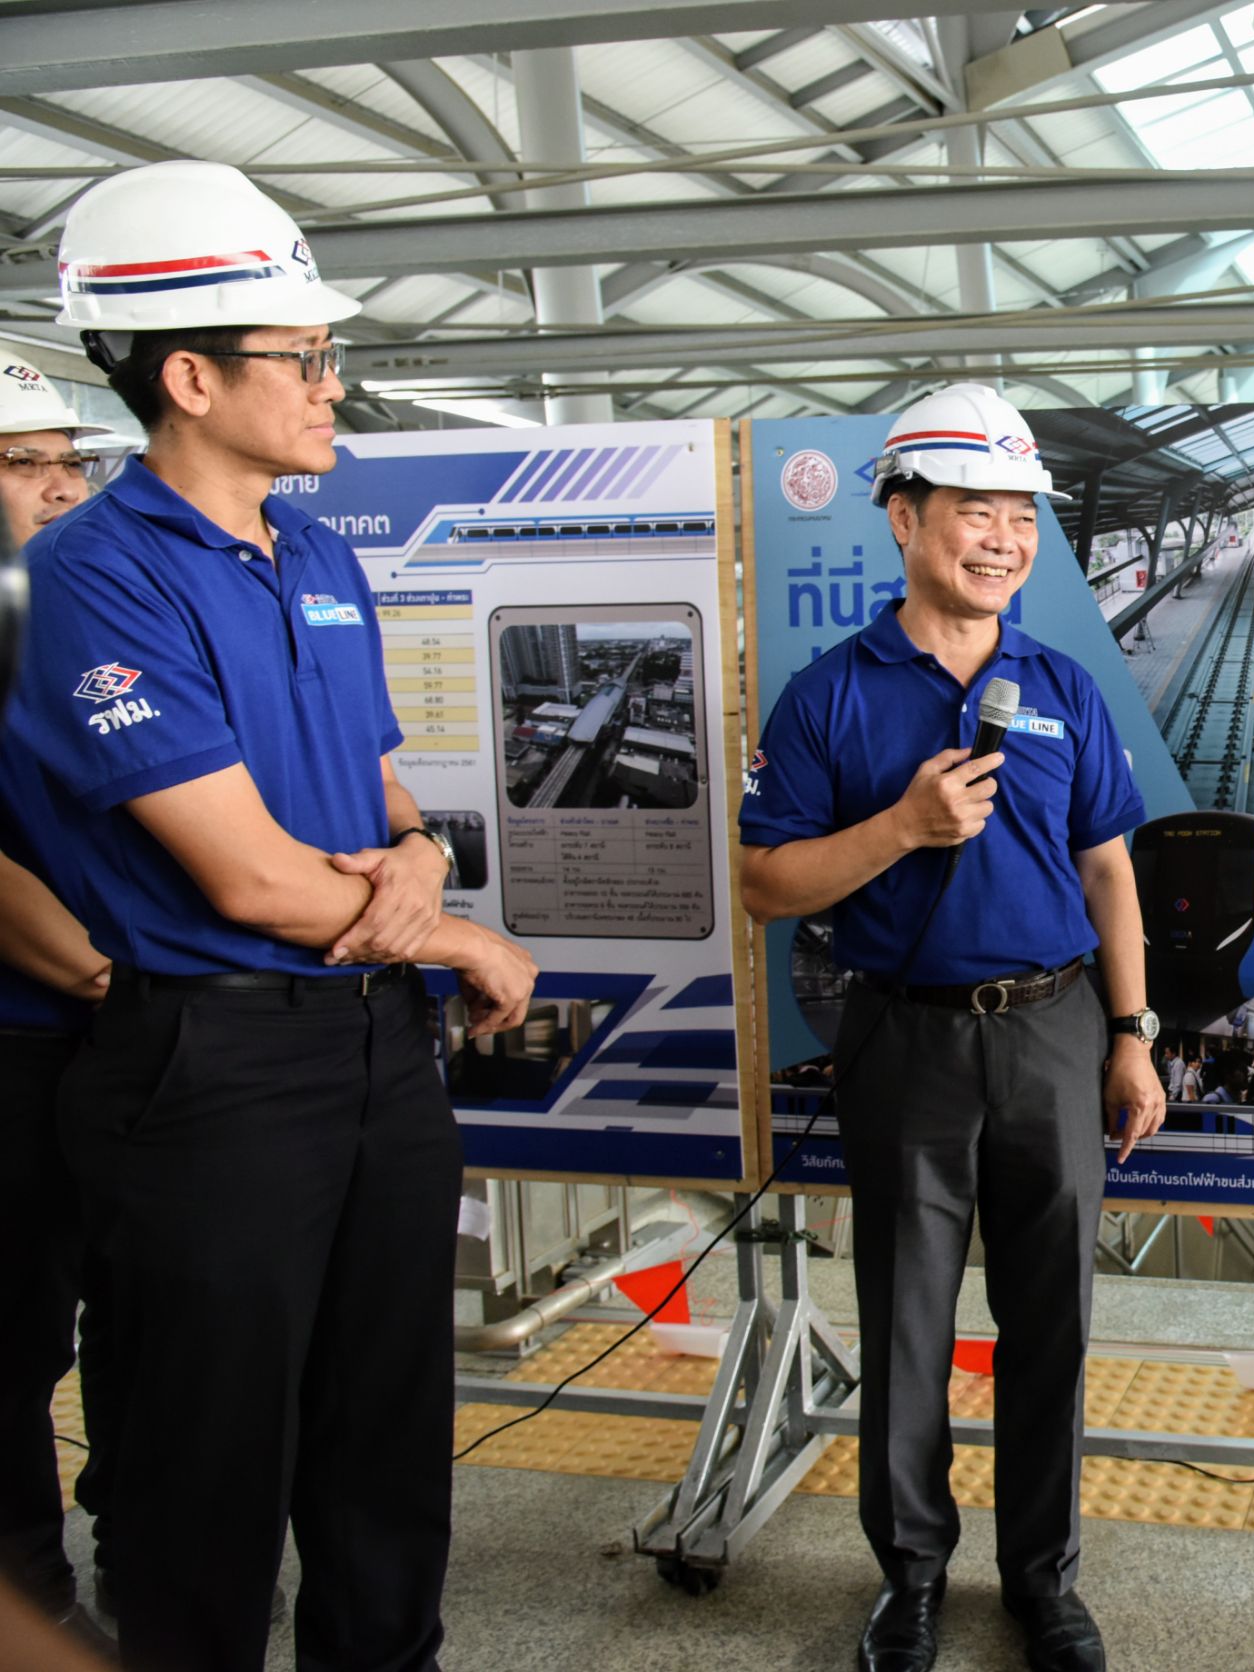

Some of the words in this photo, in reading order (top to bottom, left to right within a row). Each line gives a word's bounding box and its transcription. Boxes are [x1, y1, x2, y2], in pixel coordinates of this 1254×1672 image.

[307, 610, 338, 621] BLUE
[338, 609, 359, 620] LINE
[88, 698, 161, 735] รฟม.
[1011, 719, 1027, 729] UE
[1031, 721, 1056, 734] LINE
